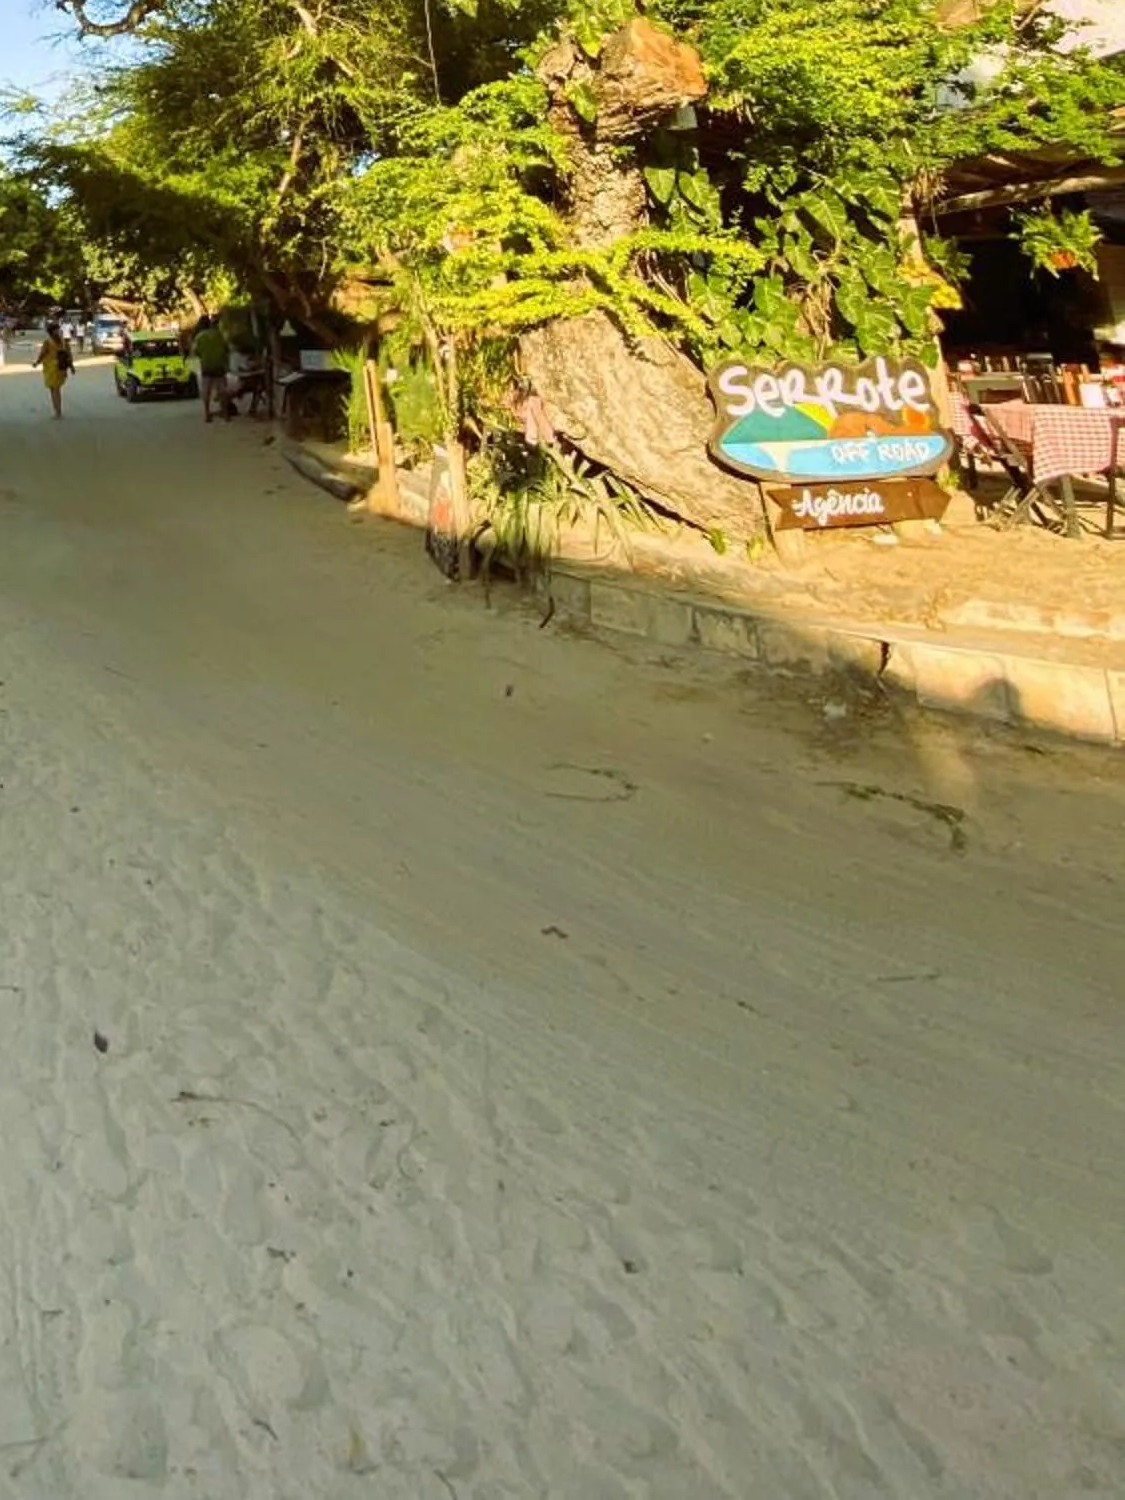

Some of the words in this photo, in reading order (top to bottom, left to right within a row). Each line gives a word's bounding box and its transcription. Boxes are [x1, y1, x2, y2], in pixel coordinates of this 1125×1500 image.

[830, 443, 870, 465] OFF
[877, 440, 930, 463] ROAD
[792, 485, 885, 526] Agência
